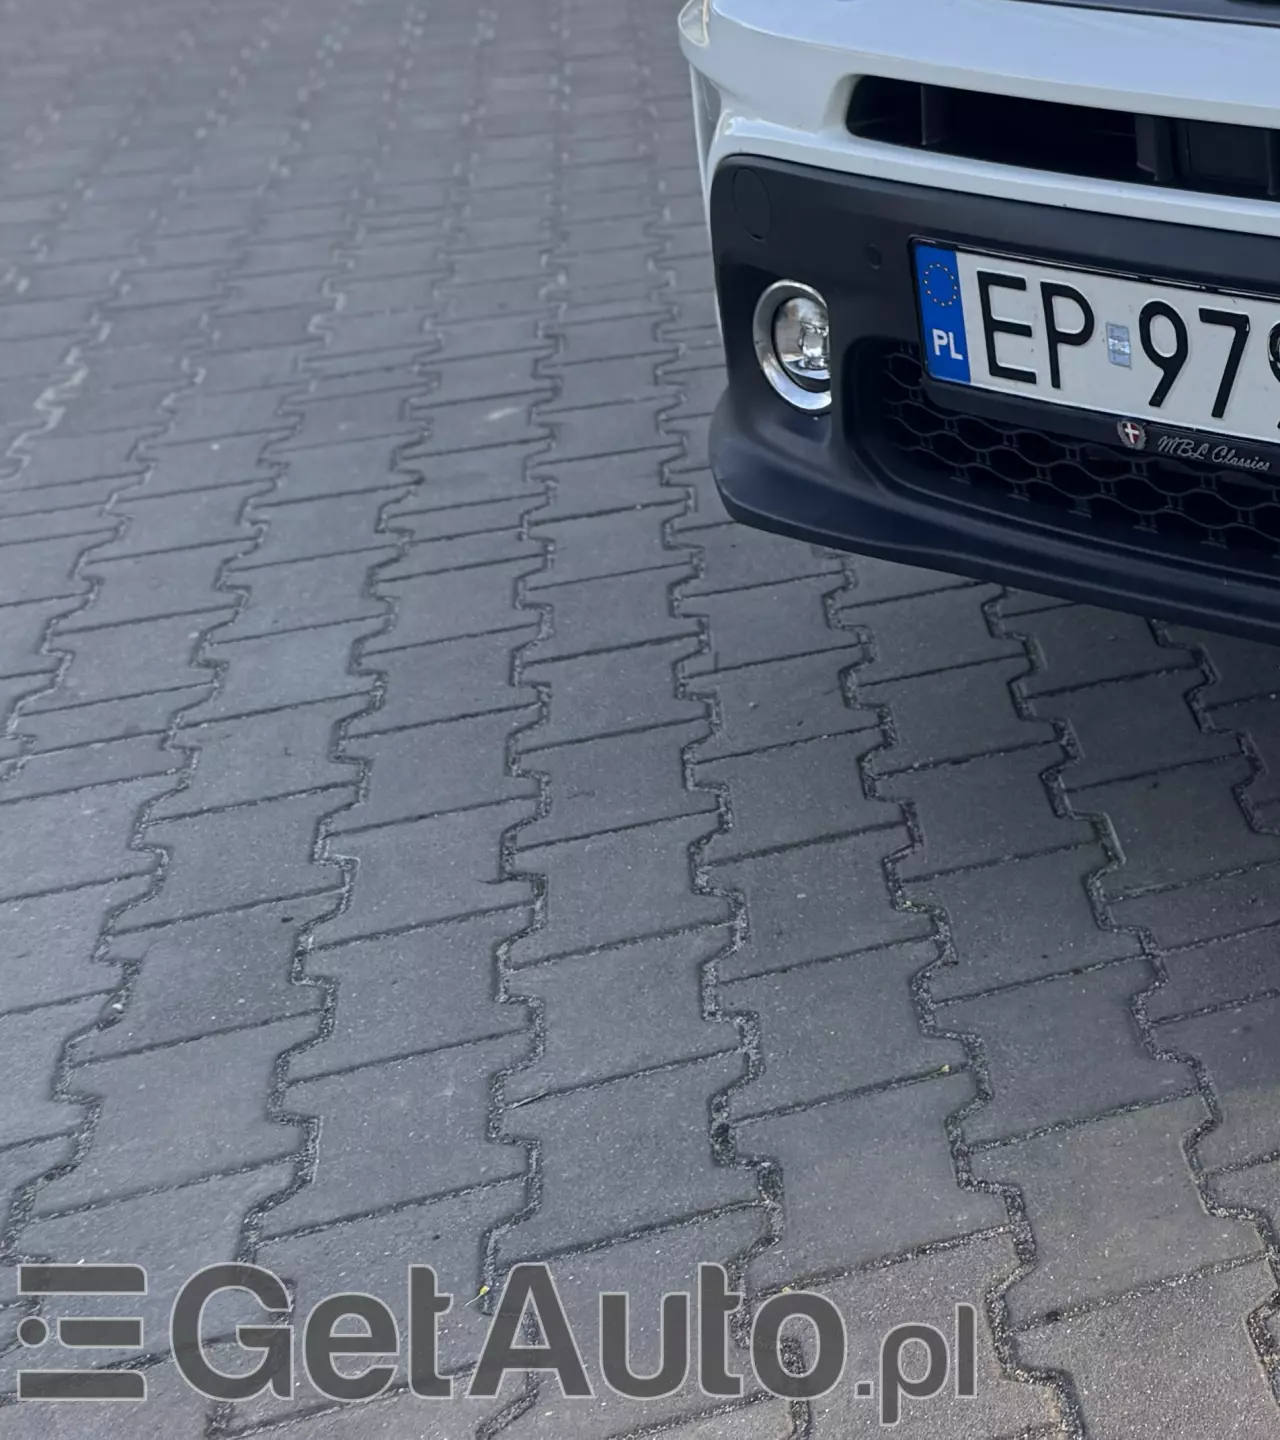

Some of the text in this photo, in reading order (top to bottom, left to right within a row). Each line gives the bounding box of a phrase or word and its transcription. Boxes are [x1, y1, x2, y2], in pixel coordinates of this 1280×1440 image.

[932, 328, 964, 360] PL
[976, 269, 1095, 390] EP
[1158, 435, 1271, 471] MBL Classics
